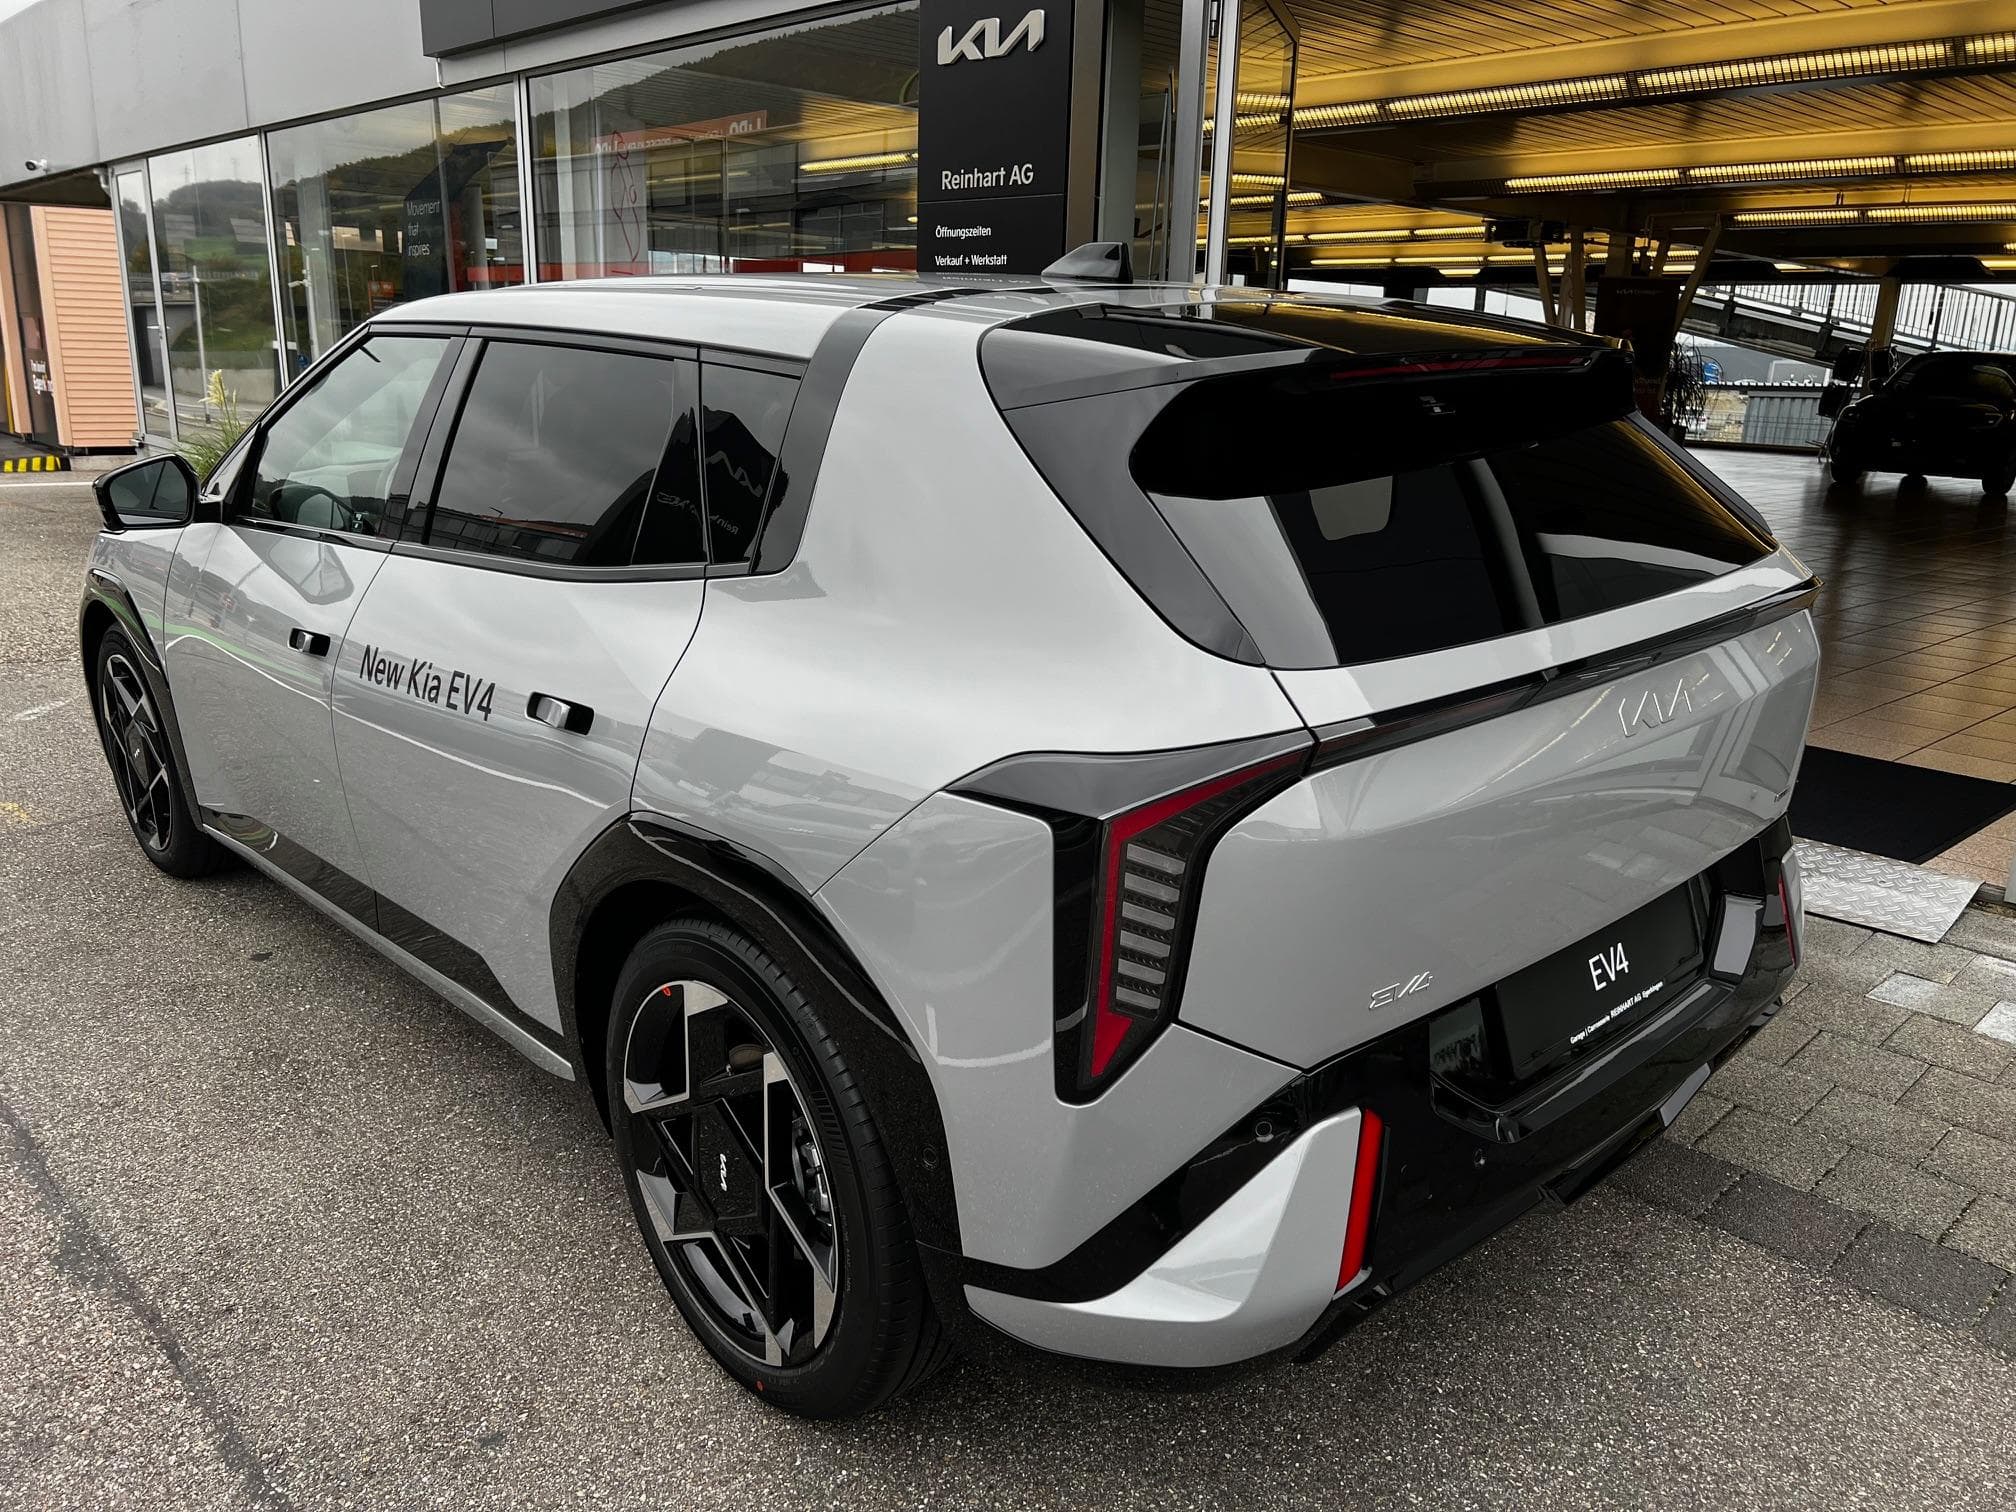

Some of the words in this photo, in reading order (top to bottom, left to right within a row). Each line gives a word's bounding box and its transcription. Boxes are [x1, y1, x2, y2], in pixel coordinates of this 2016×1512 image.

[941, 167, 1006, 190] Reinhart
[1008, 163, 1034, 186] AG
[406, 200, 441, 217] Movement
[935, 225, 992, 240] Öffnungszeiten
[935, 255, 964, 266] Verkauf
[971, 254, 1008, 266] Werkstatt
[359, 644, 405, 690] New
[406, 658, 442, 704] Kia
[445, 670, 496, 721] EV4
[1588, 942, 1629, 992] EV4
